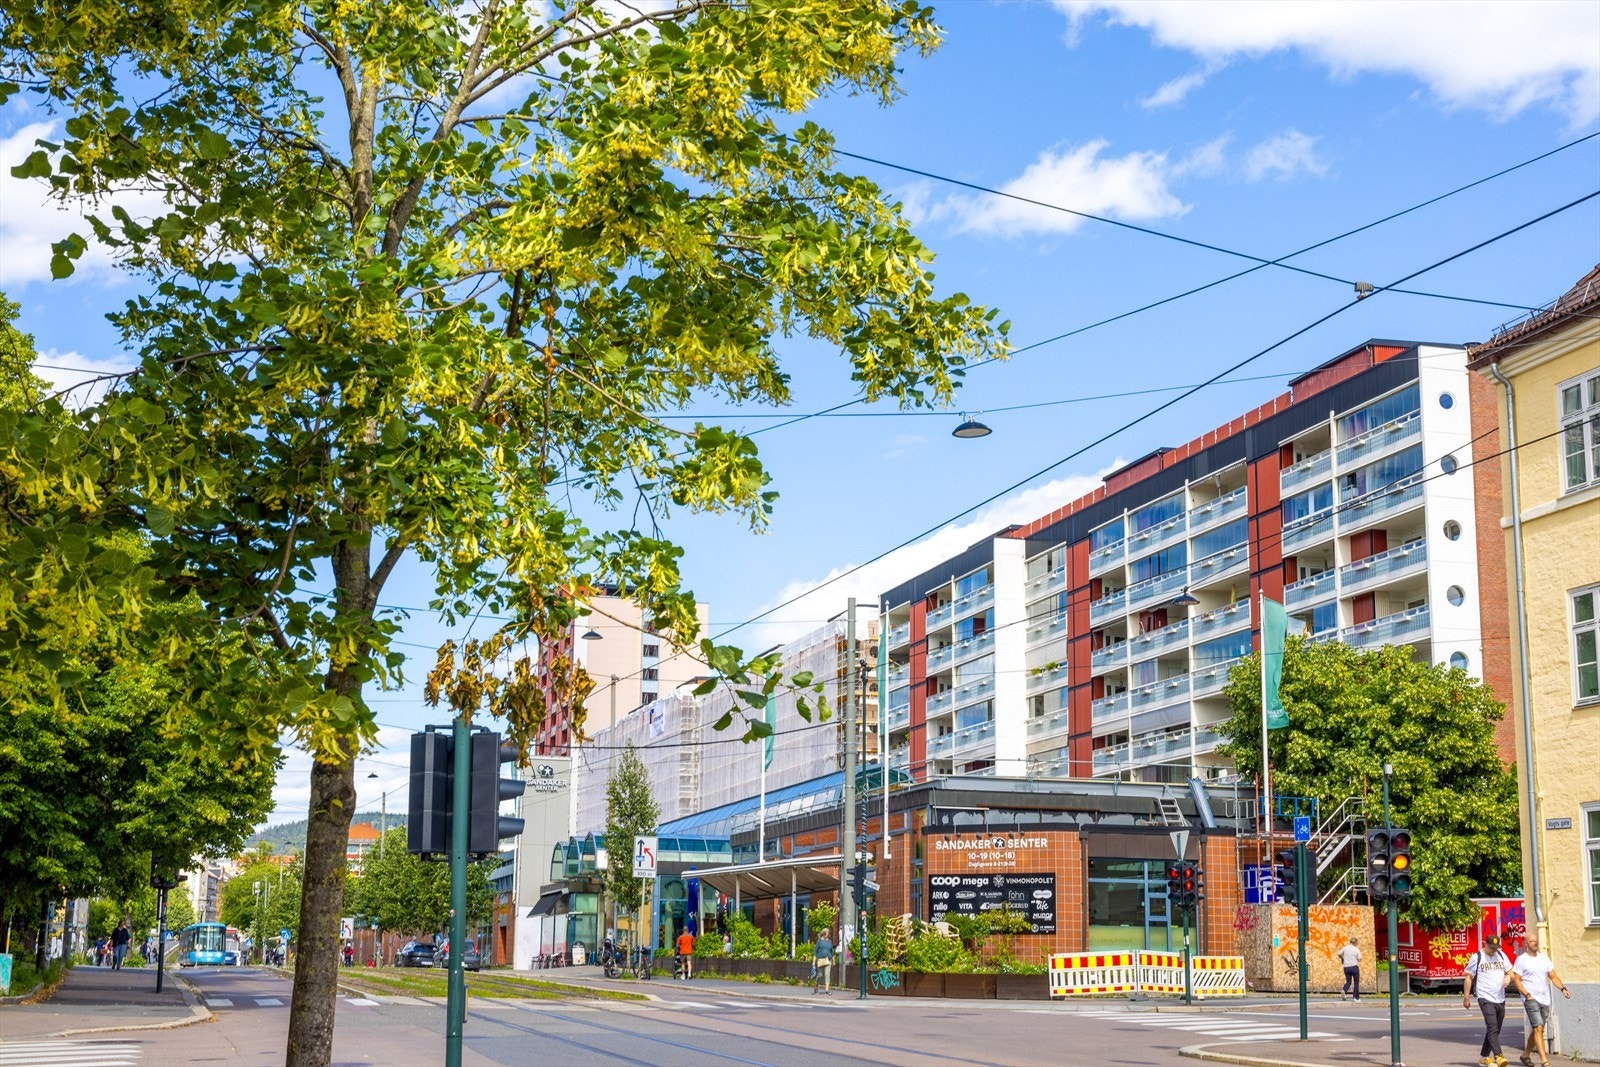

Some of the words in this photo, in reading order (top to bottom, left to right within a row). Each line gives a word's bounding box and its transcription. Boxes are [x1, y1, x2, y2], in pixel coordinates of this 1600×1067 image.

[526, 779, 568, 787] SANDAKER
[935, 840, 991, 850] SANDAKER
[1007, 838, 1048, 848] SENTER
[967, 852, 988, 860] 10-19
[989, 851, 1015, 860] (10-18)
[962, 877, 989, 887] mega
[1398, 951, 1420, 961] UTLEIE
